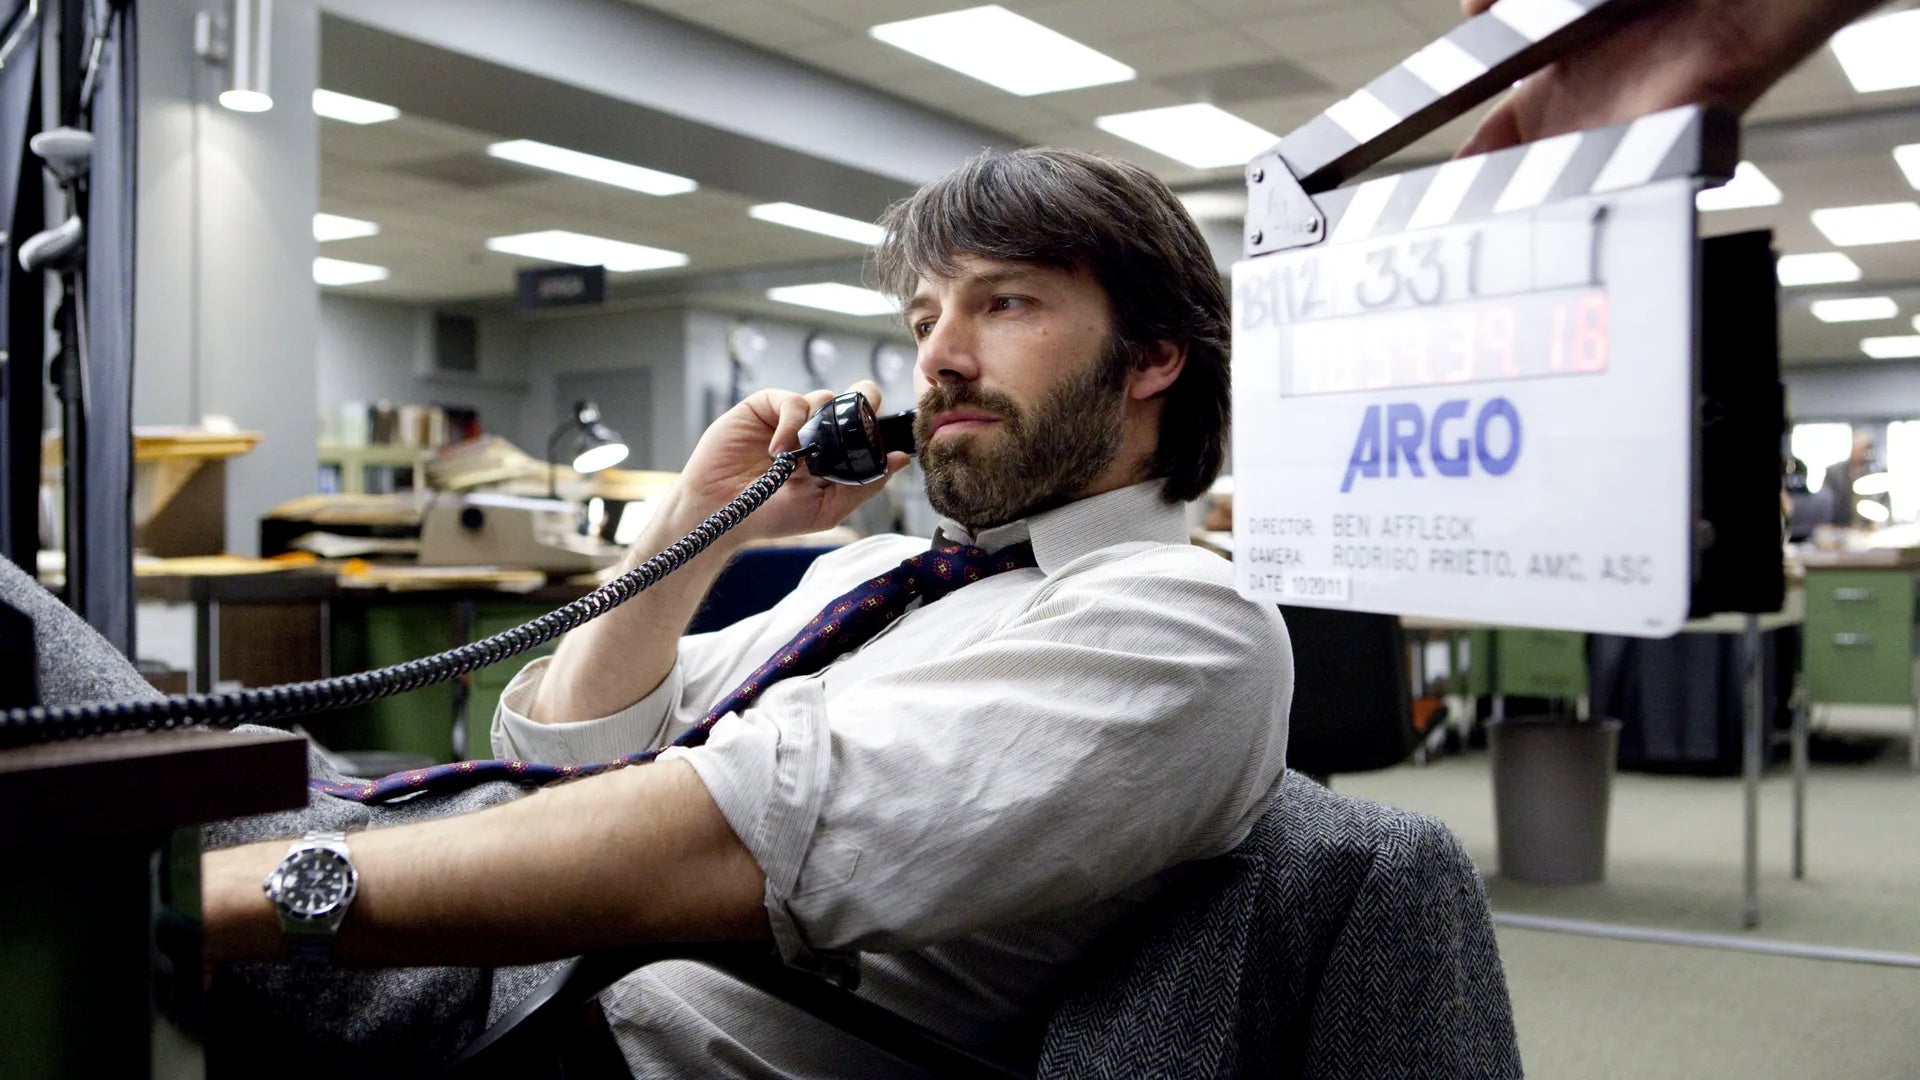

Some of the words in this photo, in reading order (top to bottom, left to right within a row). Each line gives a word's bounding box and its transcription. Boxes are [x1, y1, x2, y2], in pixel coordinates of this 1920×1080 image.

[1355, 228, 1486, 308] 331
[1339, 396, 1523, 494] ARGO
[1332, 514, 1371, 538] BEN
[1380, 514, 1477, 542] AFFLECK
[1332, 544, 1419, 572] RODRIGO
[1599, 553, 1655, 585] ASC
